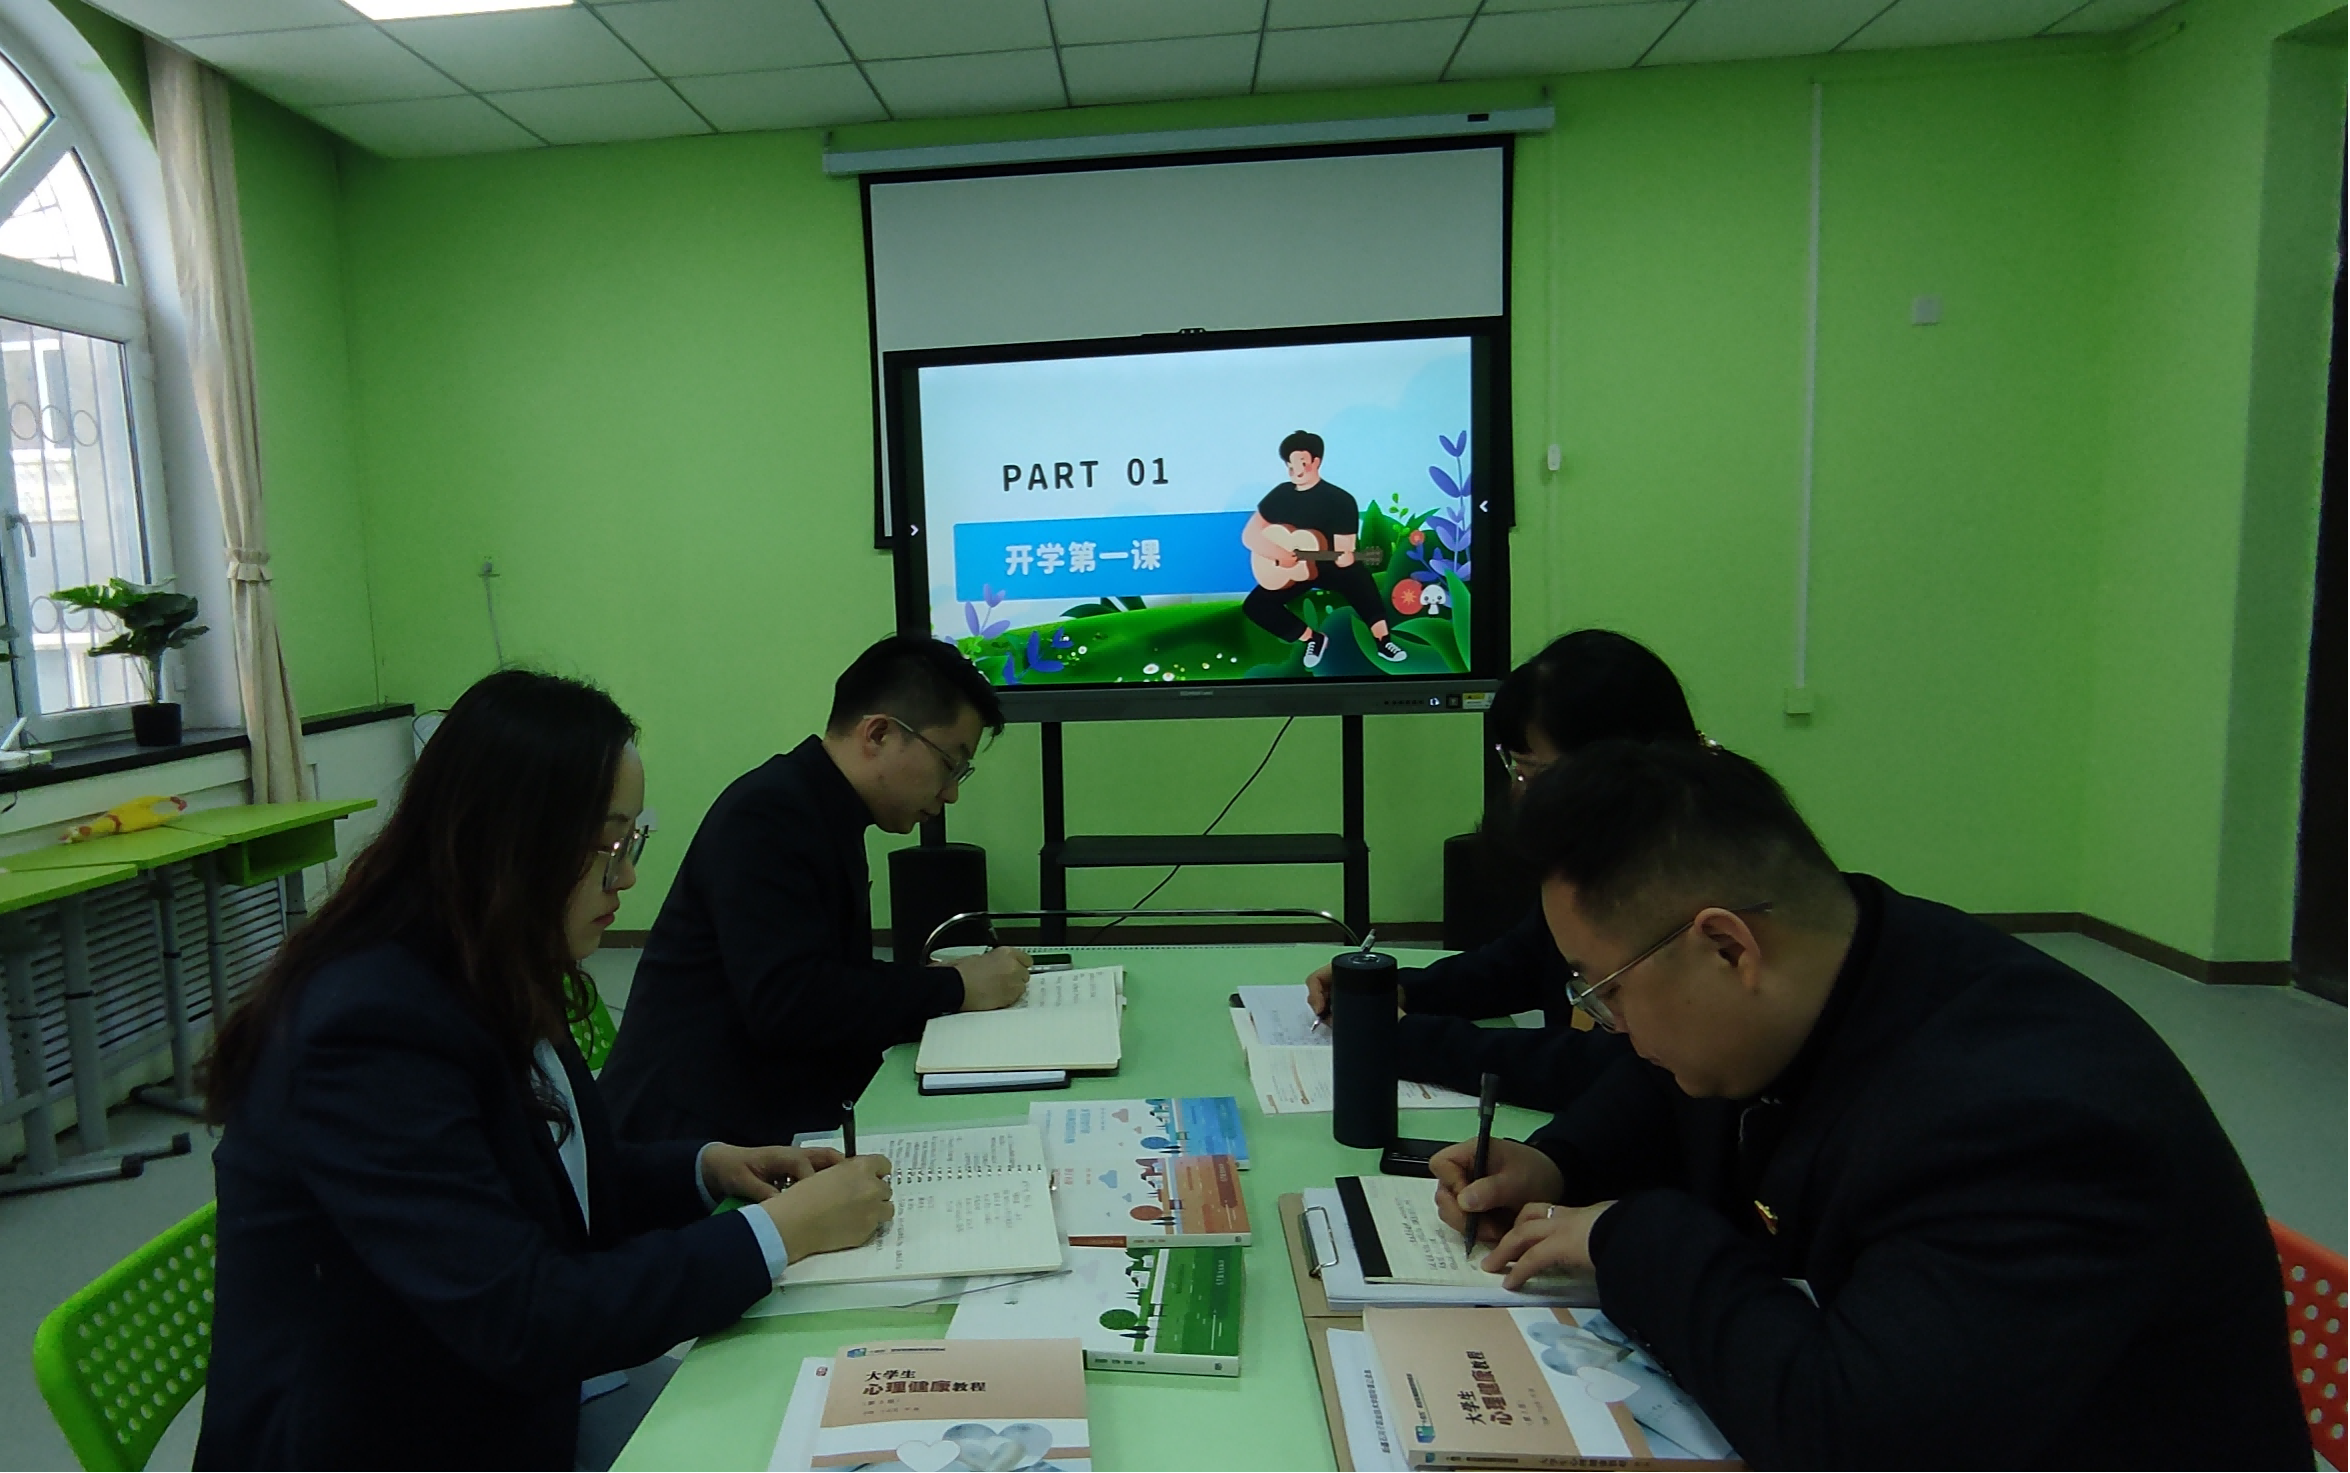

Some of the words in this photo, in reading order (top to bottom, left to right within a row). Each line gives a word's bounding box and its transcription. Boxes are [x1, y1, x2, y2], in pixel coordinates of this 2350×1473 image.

[1002, 460, 1099, 492] PART
[1127, 457, 1169, 487] 01
[1005, 539, 1161, 576] 开学第一课
[862, 1379, 987, 1395] 心理健康教程
[865, 1369, 917, 1381] 大学生
[1457, 1390, 1487, 1425] 大学生
